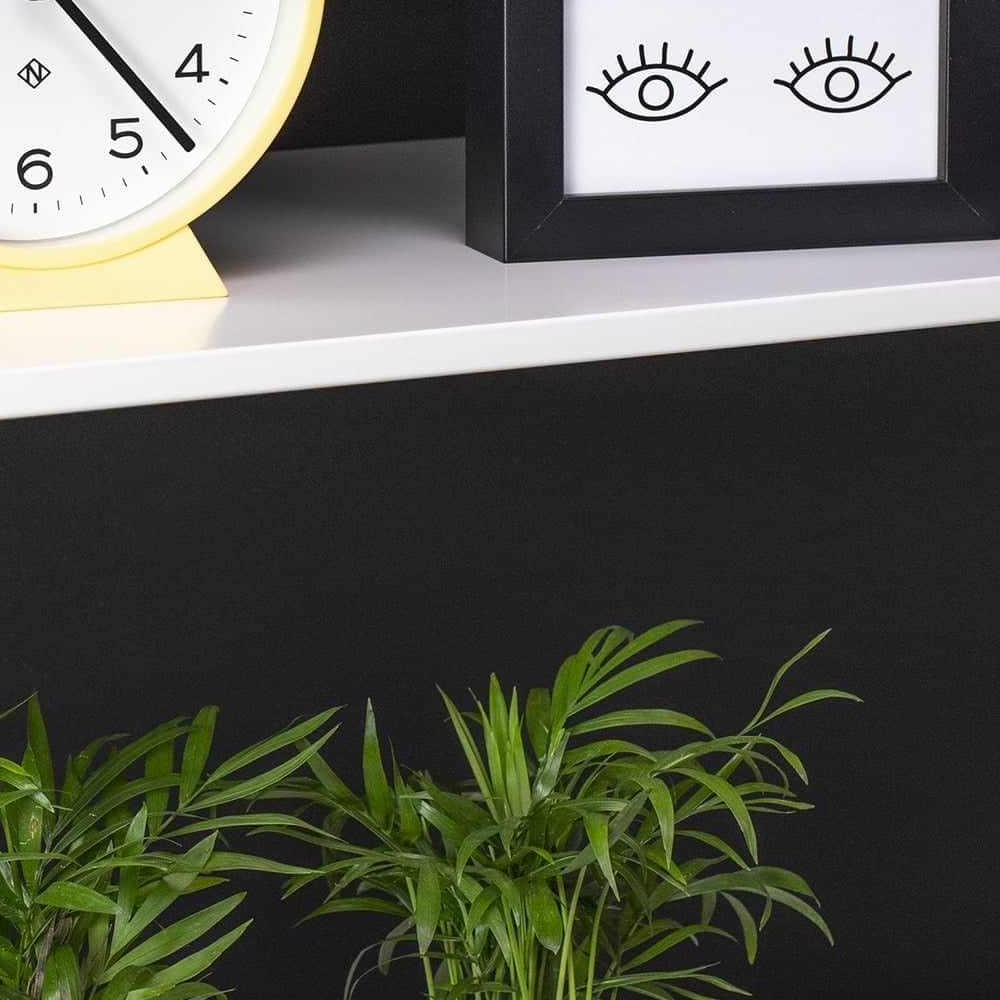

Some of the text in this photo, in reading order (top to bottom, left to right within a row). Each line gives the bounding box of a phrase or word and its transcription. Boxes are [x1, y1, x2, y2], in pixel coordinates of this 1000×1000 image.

[174, 43, 210, 84] 4
[108, 117, 144, 159] 5
[16, 148, 54, 191] 6
